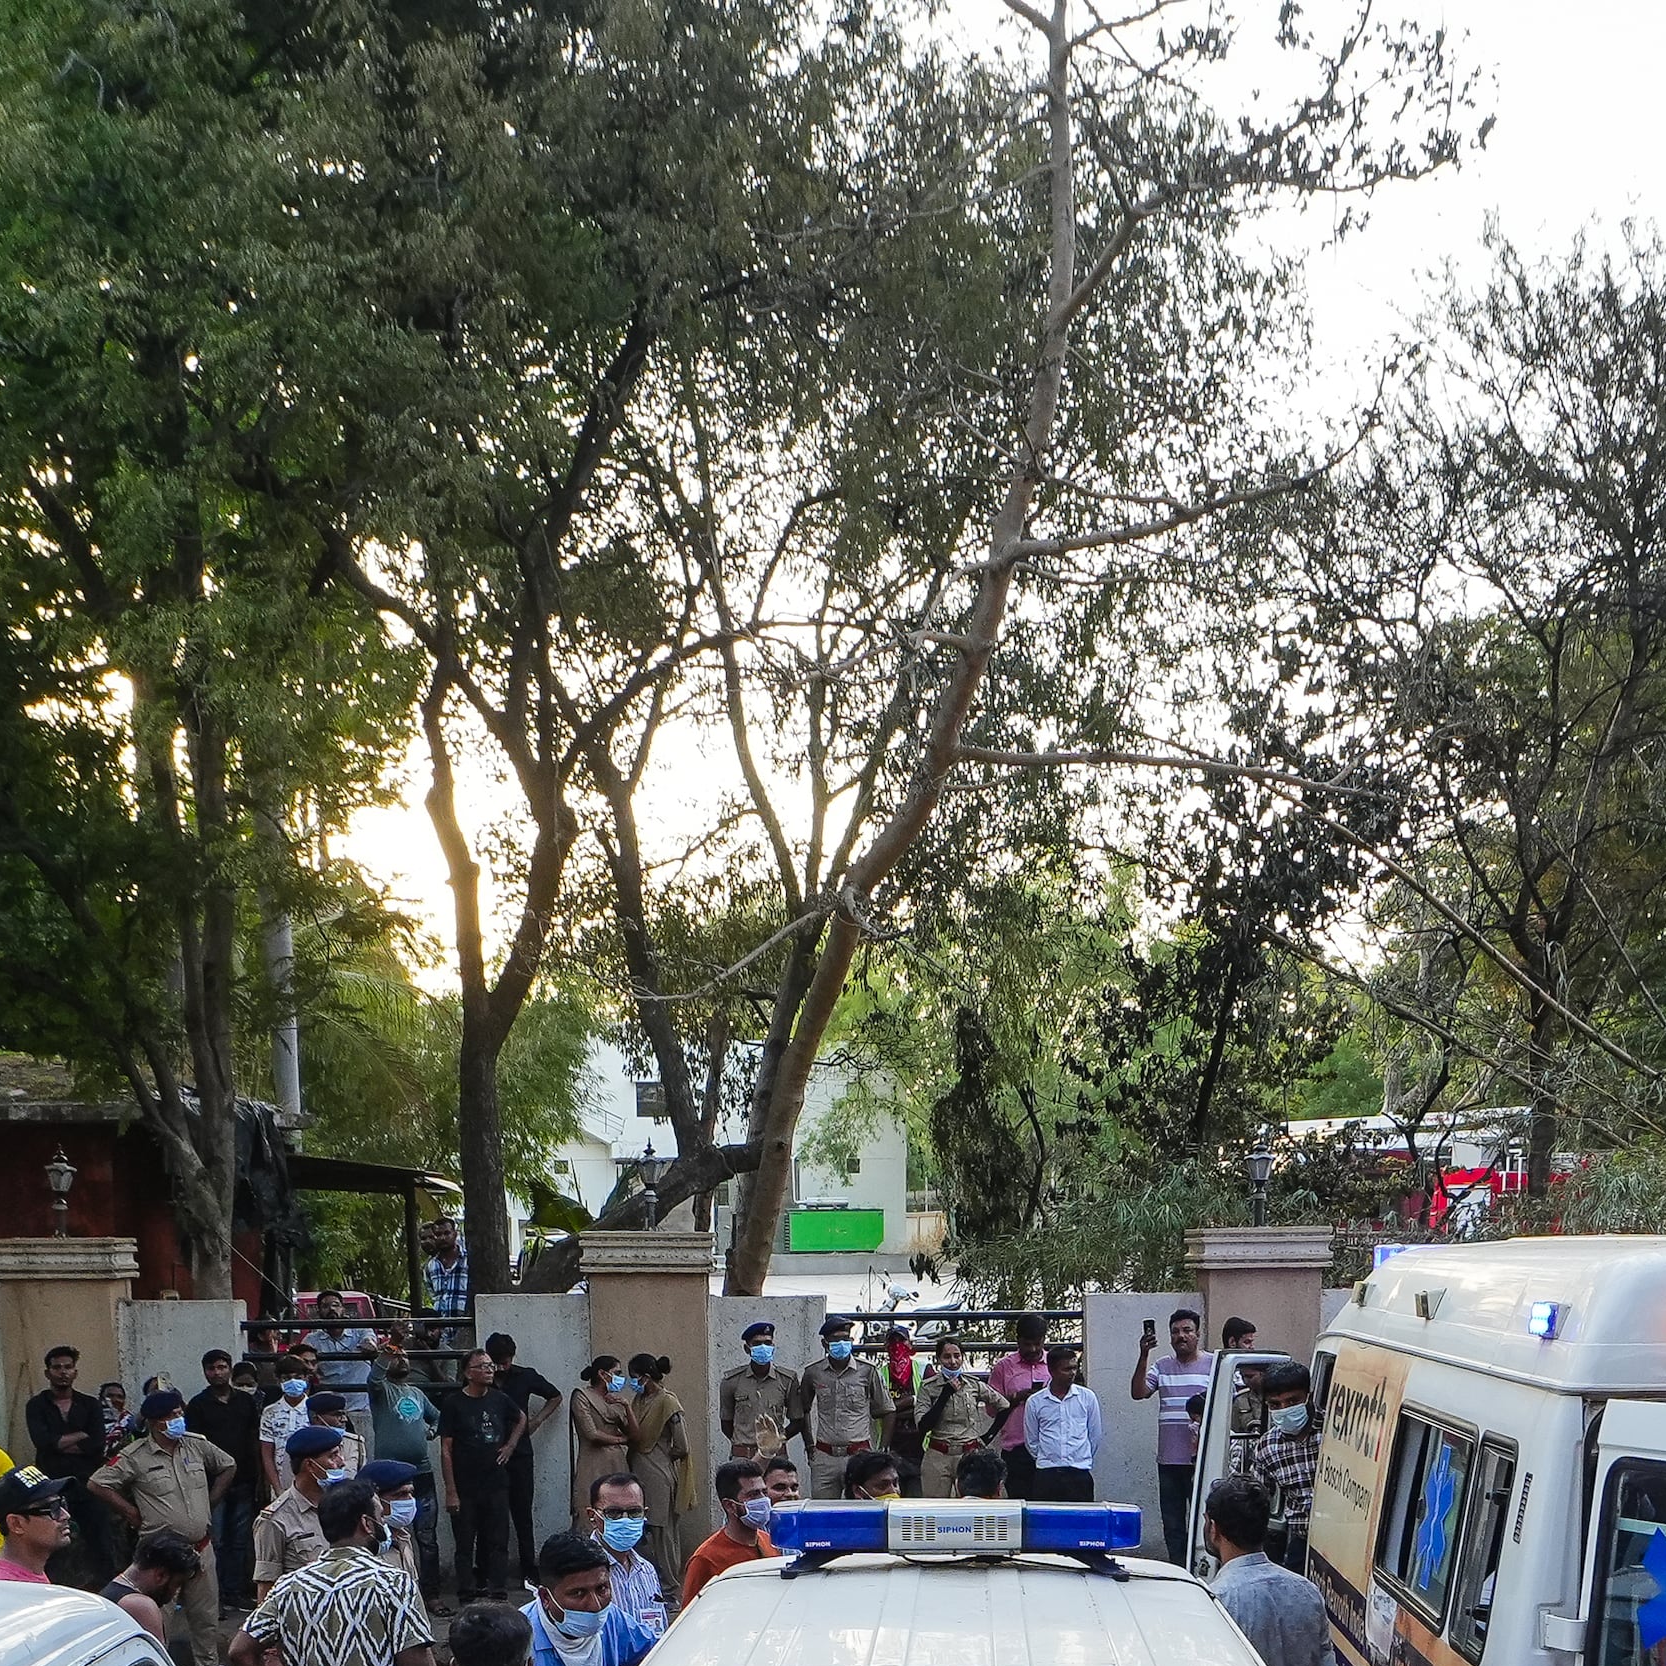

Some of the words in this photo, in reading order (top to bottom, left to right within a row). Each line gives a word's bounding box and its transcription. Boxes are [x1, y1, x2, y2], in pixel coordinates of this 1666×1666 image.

[1324, 1376, 1388, 1463] rexroth
[1324, 1458, 1343, 1493] Bosch
[1342, 1469, 1373, 1521] Company
[937, 1525, 972, 1534] SIPHON
